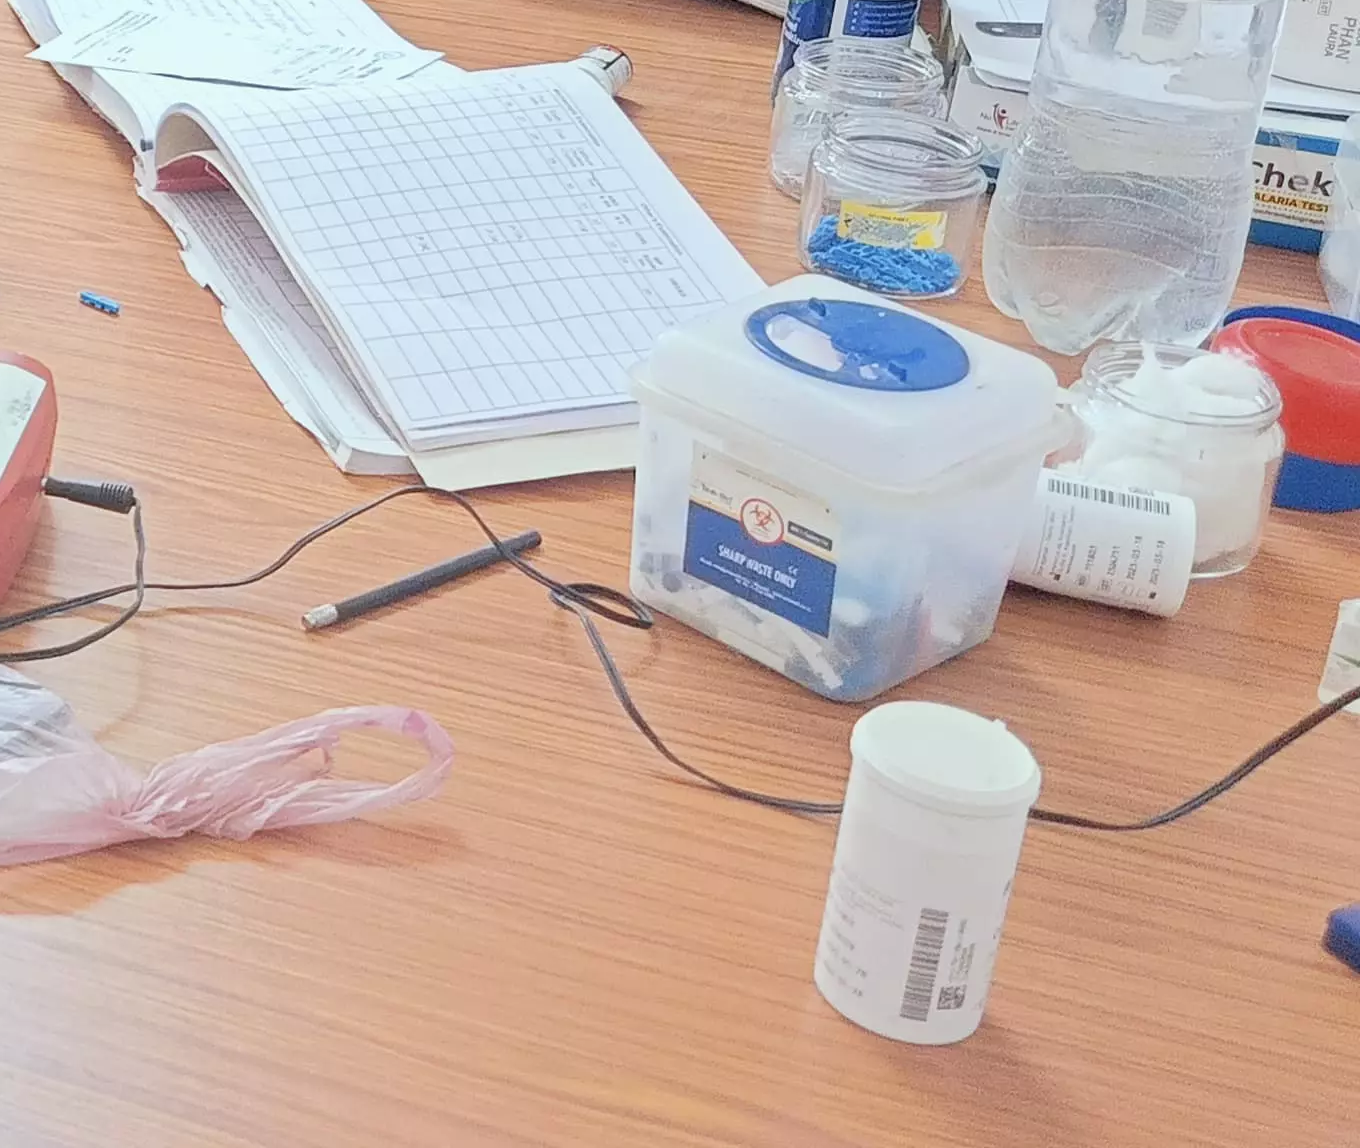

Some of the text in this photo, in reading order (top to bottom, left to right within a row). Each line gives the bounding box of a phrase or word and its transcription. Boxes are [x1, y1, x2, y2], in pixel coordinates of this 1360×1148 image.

[1324, 23, 1339, 57] LAURA
[1254, 192, 1297, 208] ALARIA
[718, 543, 746, 566] SHARP
[746, 556, 773, 581] WASTE
[774, 568, 797, 589] ONLY
